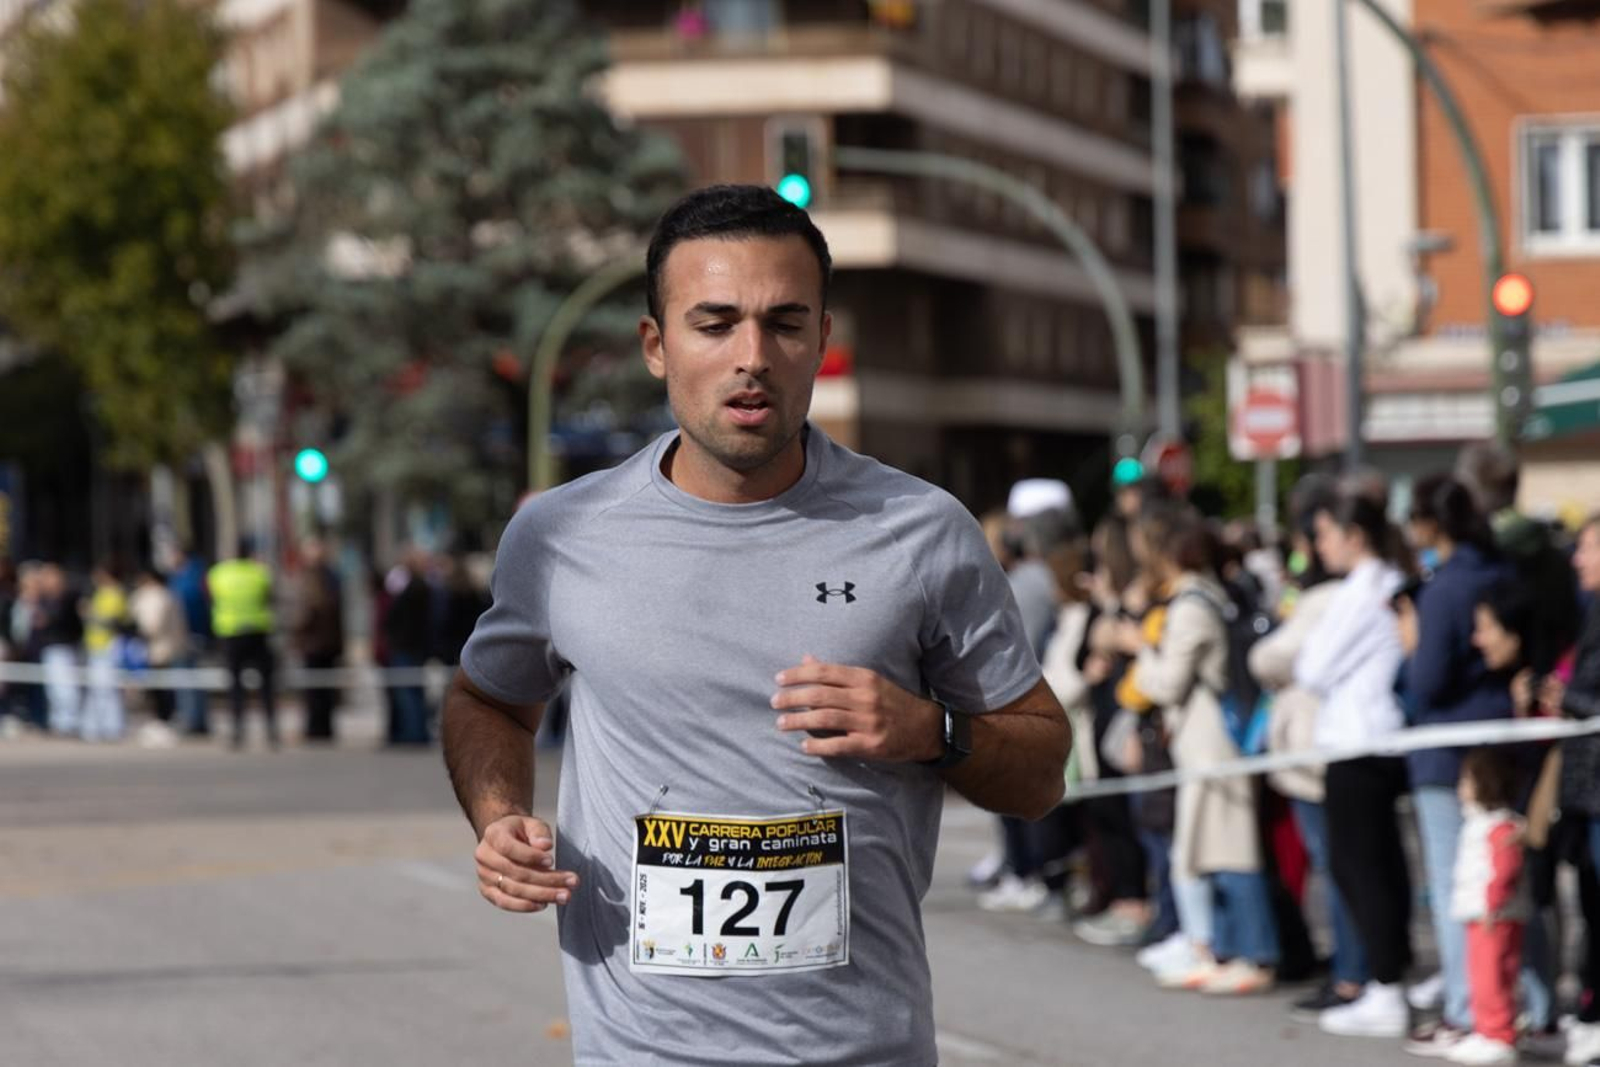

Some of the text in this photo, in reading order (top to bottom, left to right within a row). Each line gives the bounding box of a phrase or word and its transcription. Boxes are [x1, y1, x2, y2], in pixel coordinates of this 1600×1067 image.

[643, 819, 687, 849] XXV
[688, 819, 837, 839] CARRERA POPULAR
[688, 832, 838, 852] y gran caminata
[661, 852, 684, 865] POR
[684, 854, 703, 867] LA
[737, 856, 755, 869] LA
[680, 878, 805, 937] 127
